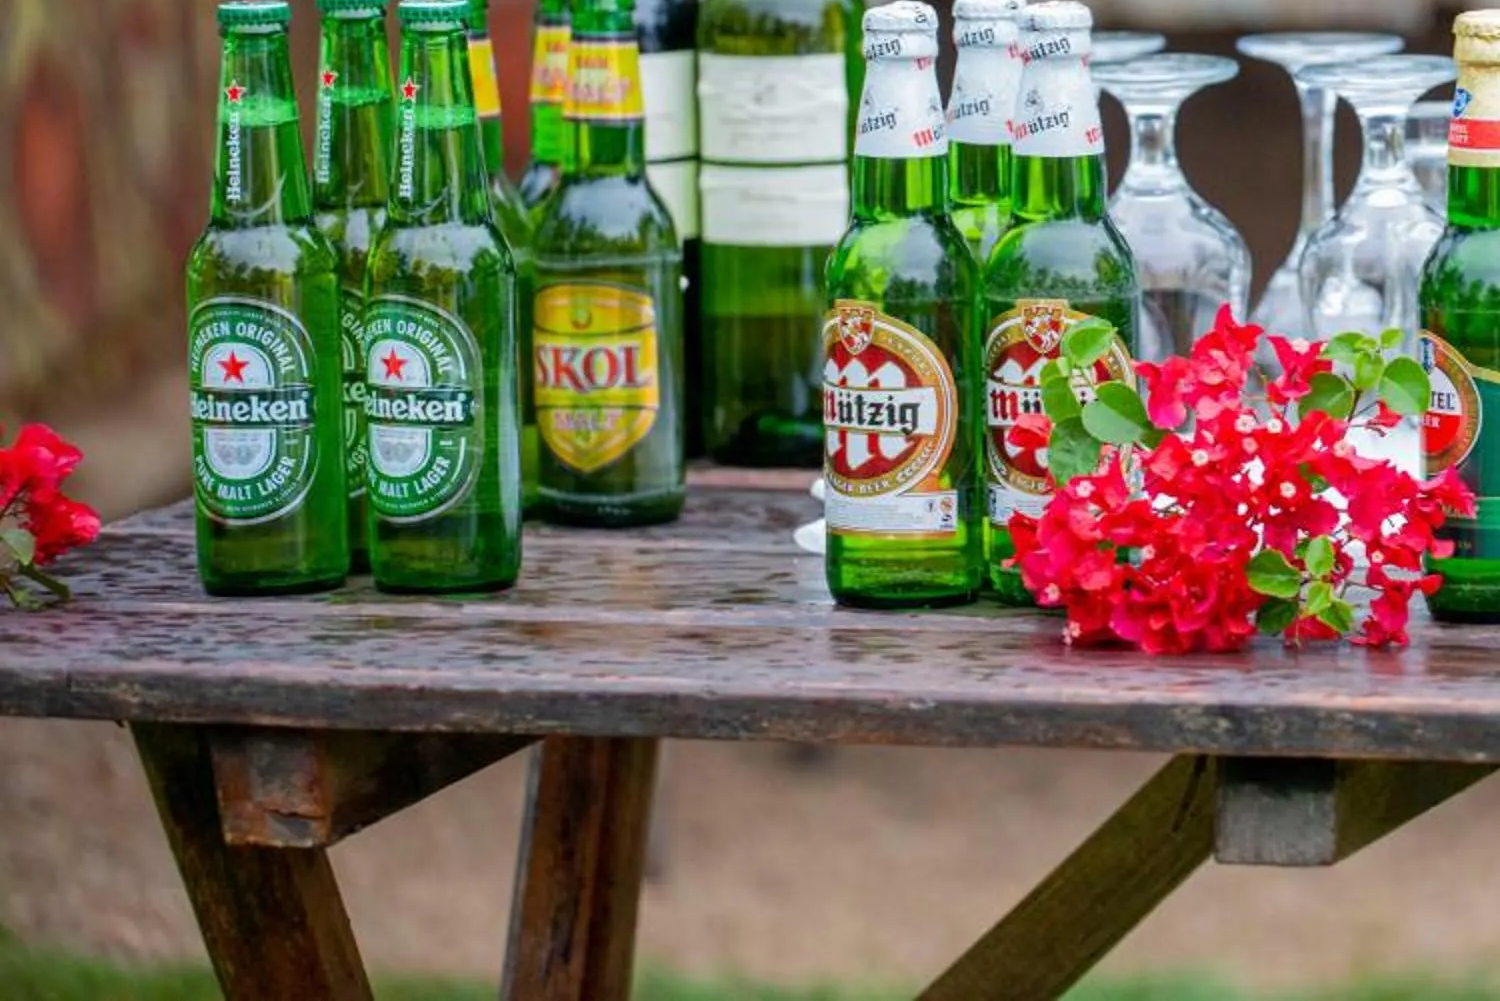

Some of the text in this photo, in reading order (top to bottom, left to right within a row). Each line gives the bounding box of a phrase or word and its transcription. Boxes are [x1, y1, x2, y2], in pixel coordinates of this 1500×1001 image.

[226, 112, 241, 202] Heineken
[399, 108, 415, 199] Heineken
[235, 322, 296, 374] ORIGINAL
[396, 319, 454, 375] ORIGINAL
[536, 344, 654, 394] SKOL
[364, 393, 465, 422] eineken
[1430, 392, 1455, 410] TEL
[216, 483, 253, 501] MALT
[257, 455, 297, 497] LAGER
[414, 455, 451, 495] LAGER
